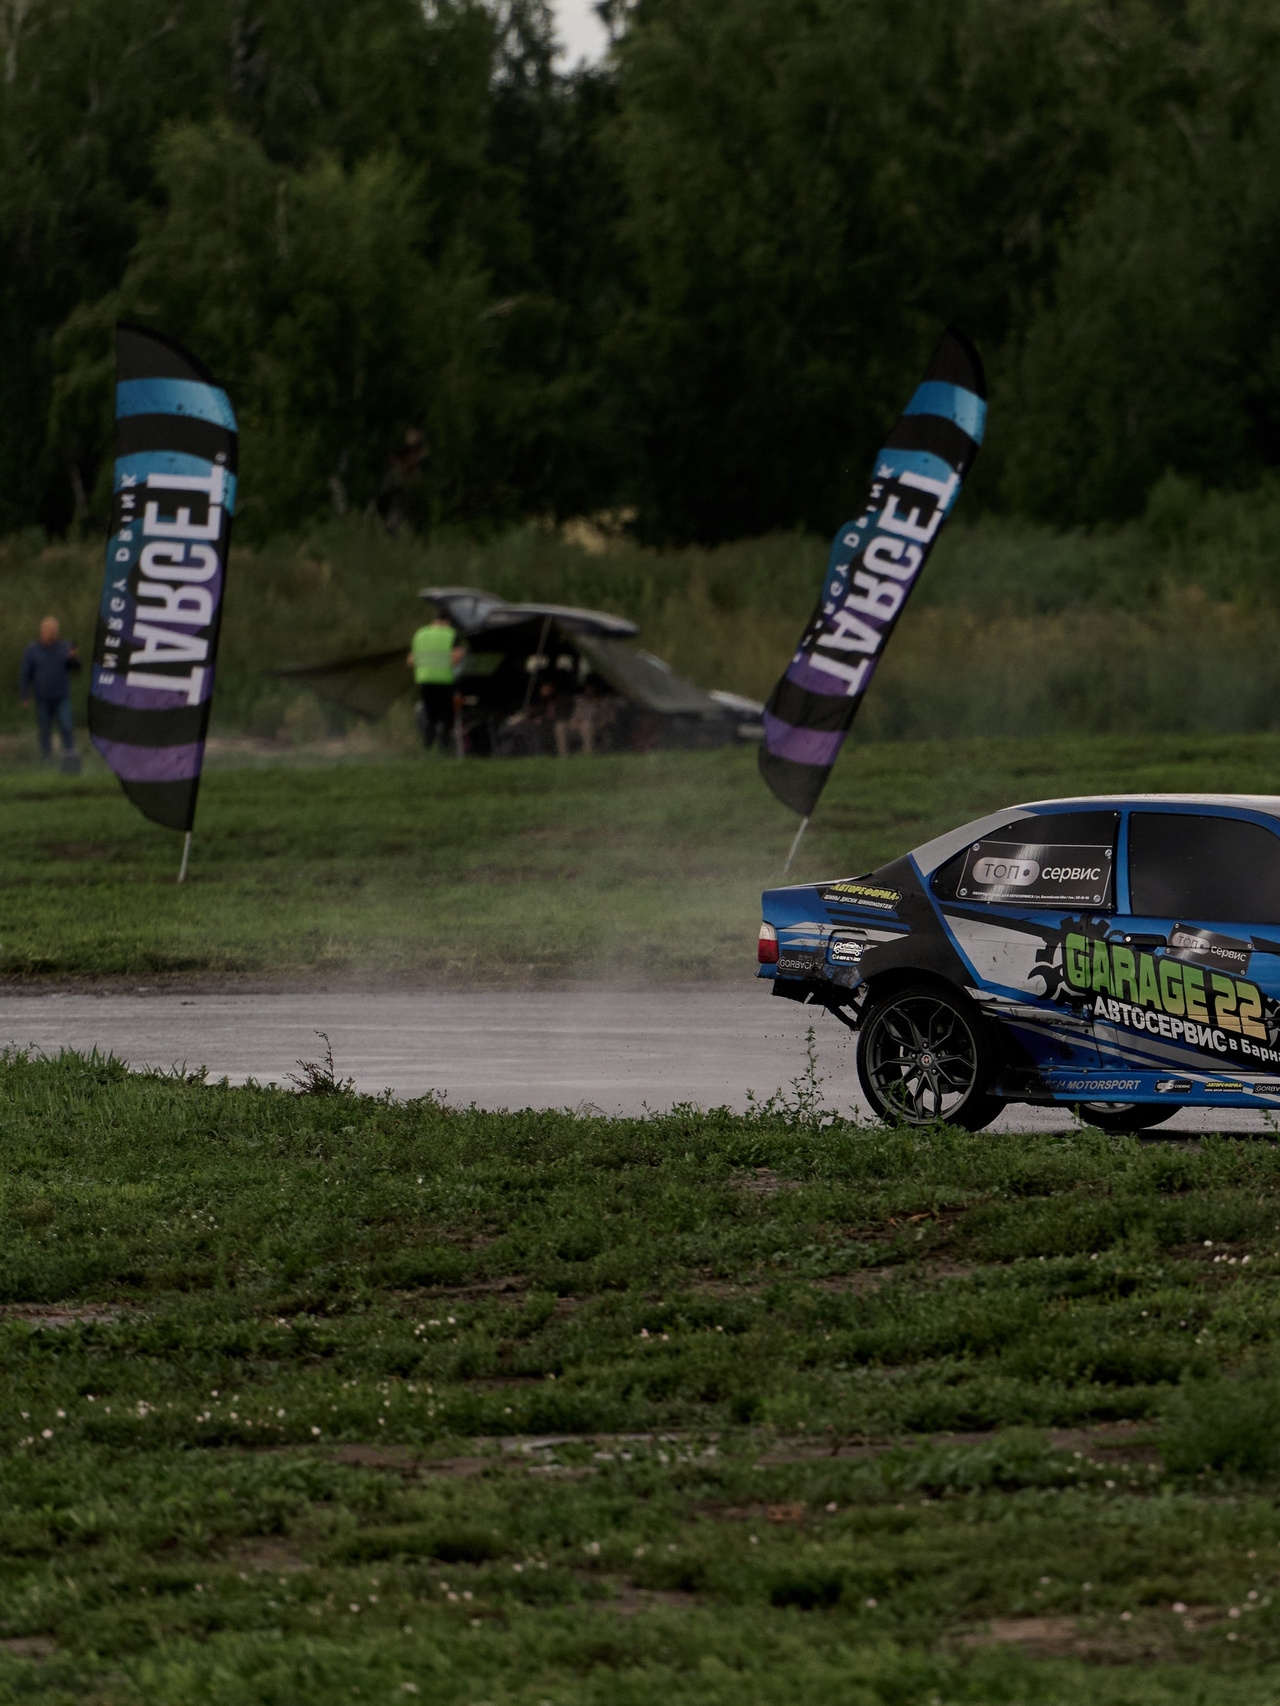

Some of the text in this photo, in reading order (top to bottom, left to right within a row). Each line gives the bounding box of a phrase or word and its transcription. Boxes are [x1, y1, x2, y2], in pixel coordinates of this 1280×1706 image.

[984, 863, 1101, 883] ТОП сервис
[1210, 945, 1247, 962] сервис
[1065, 932, 1268, 1041] GARAGE 22
[1229, 1037, 1239, 1050] в
[1067, 1080, 1141, 1090] MOTORSPORT
